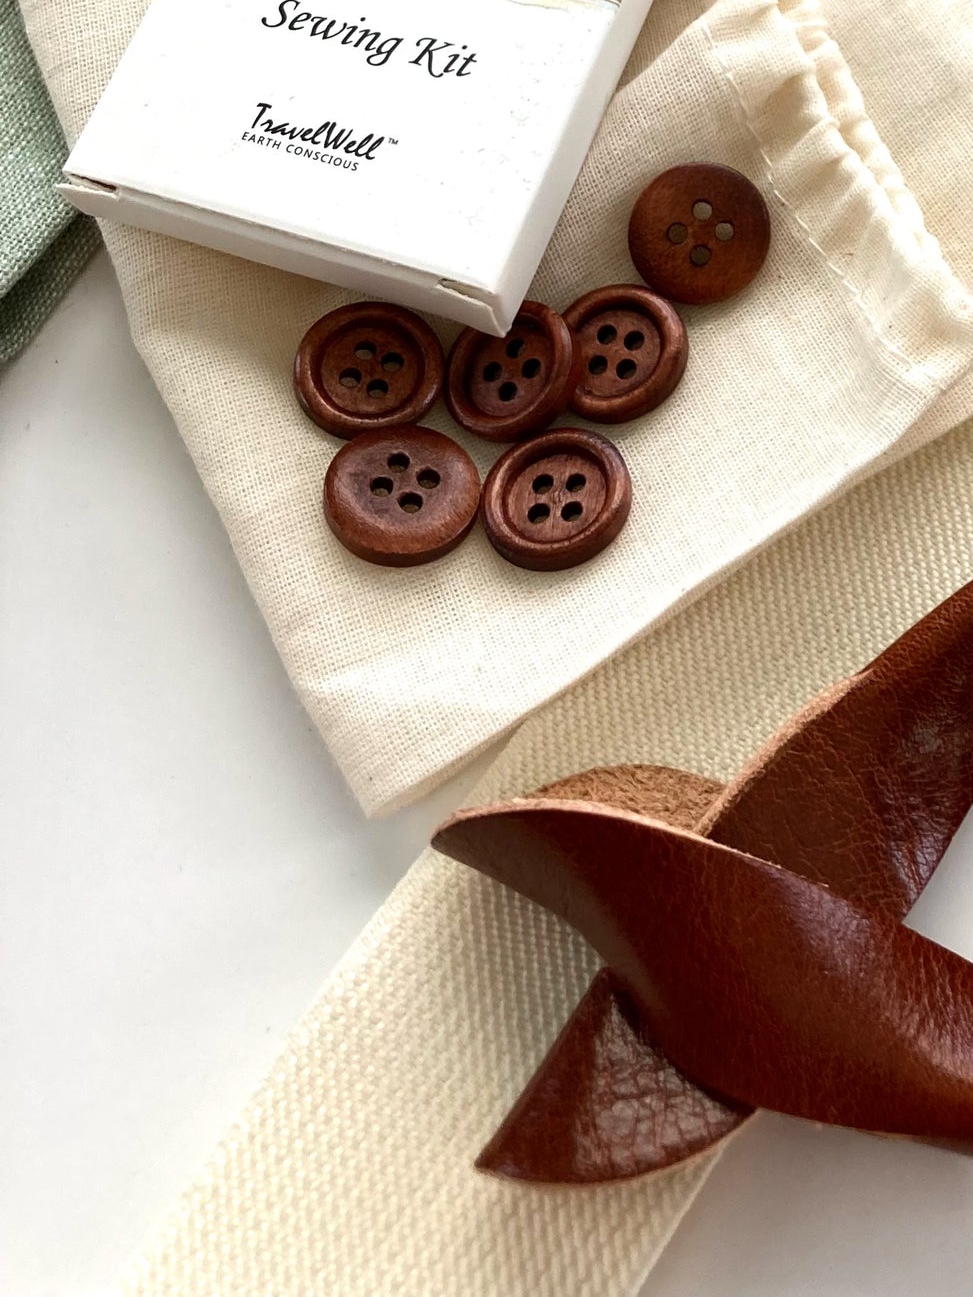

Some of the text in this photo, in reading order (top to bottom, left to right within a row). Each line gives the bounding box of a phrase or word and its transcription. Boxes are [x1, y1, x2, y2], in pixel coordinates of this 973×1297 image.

[408, 37, 478, 79] Kit
[241, 131, 360, 172] EARTH CONSCIOUS
